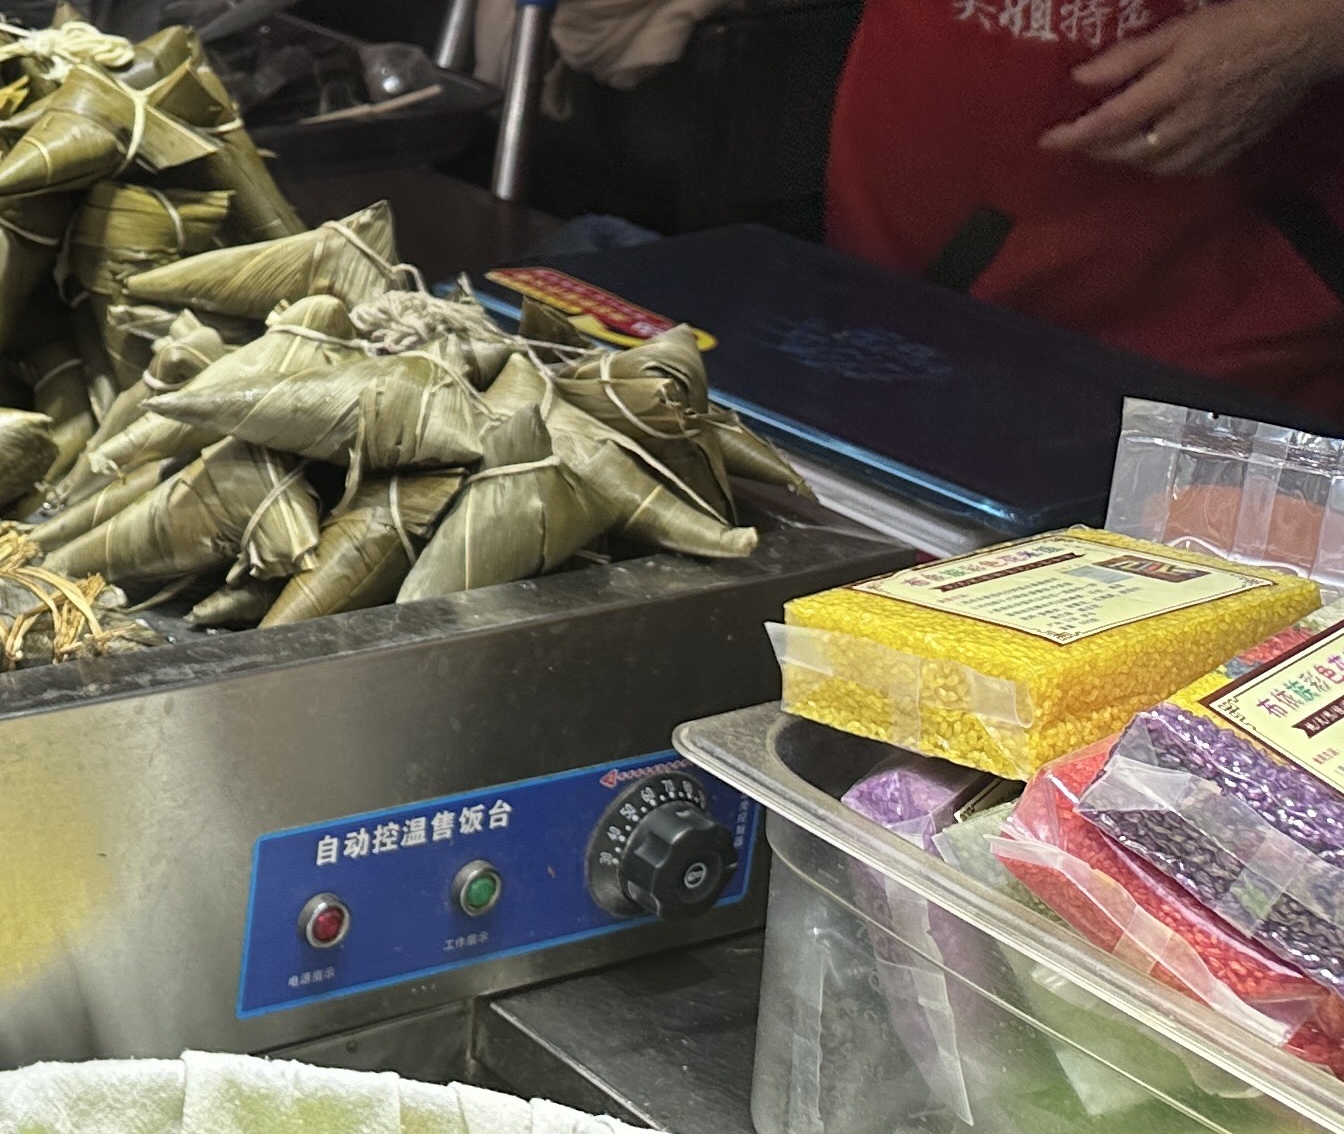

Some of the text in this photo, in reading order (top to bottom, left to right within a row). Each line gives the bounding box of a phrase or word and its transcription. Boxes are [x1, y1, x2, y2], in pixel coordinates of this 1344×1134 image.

[315, 799, 513, 867] 自动控温售饭台
